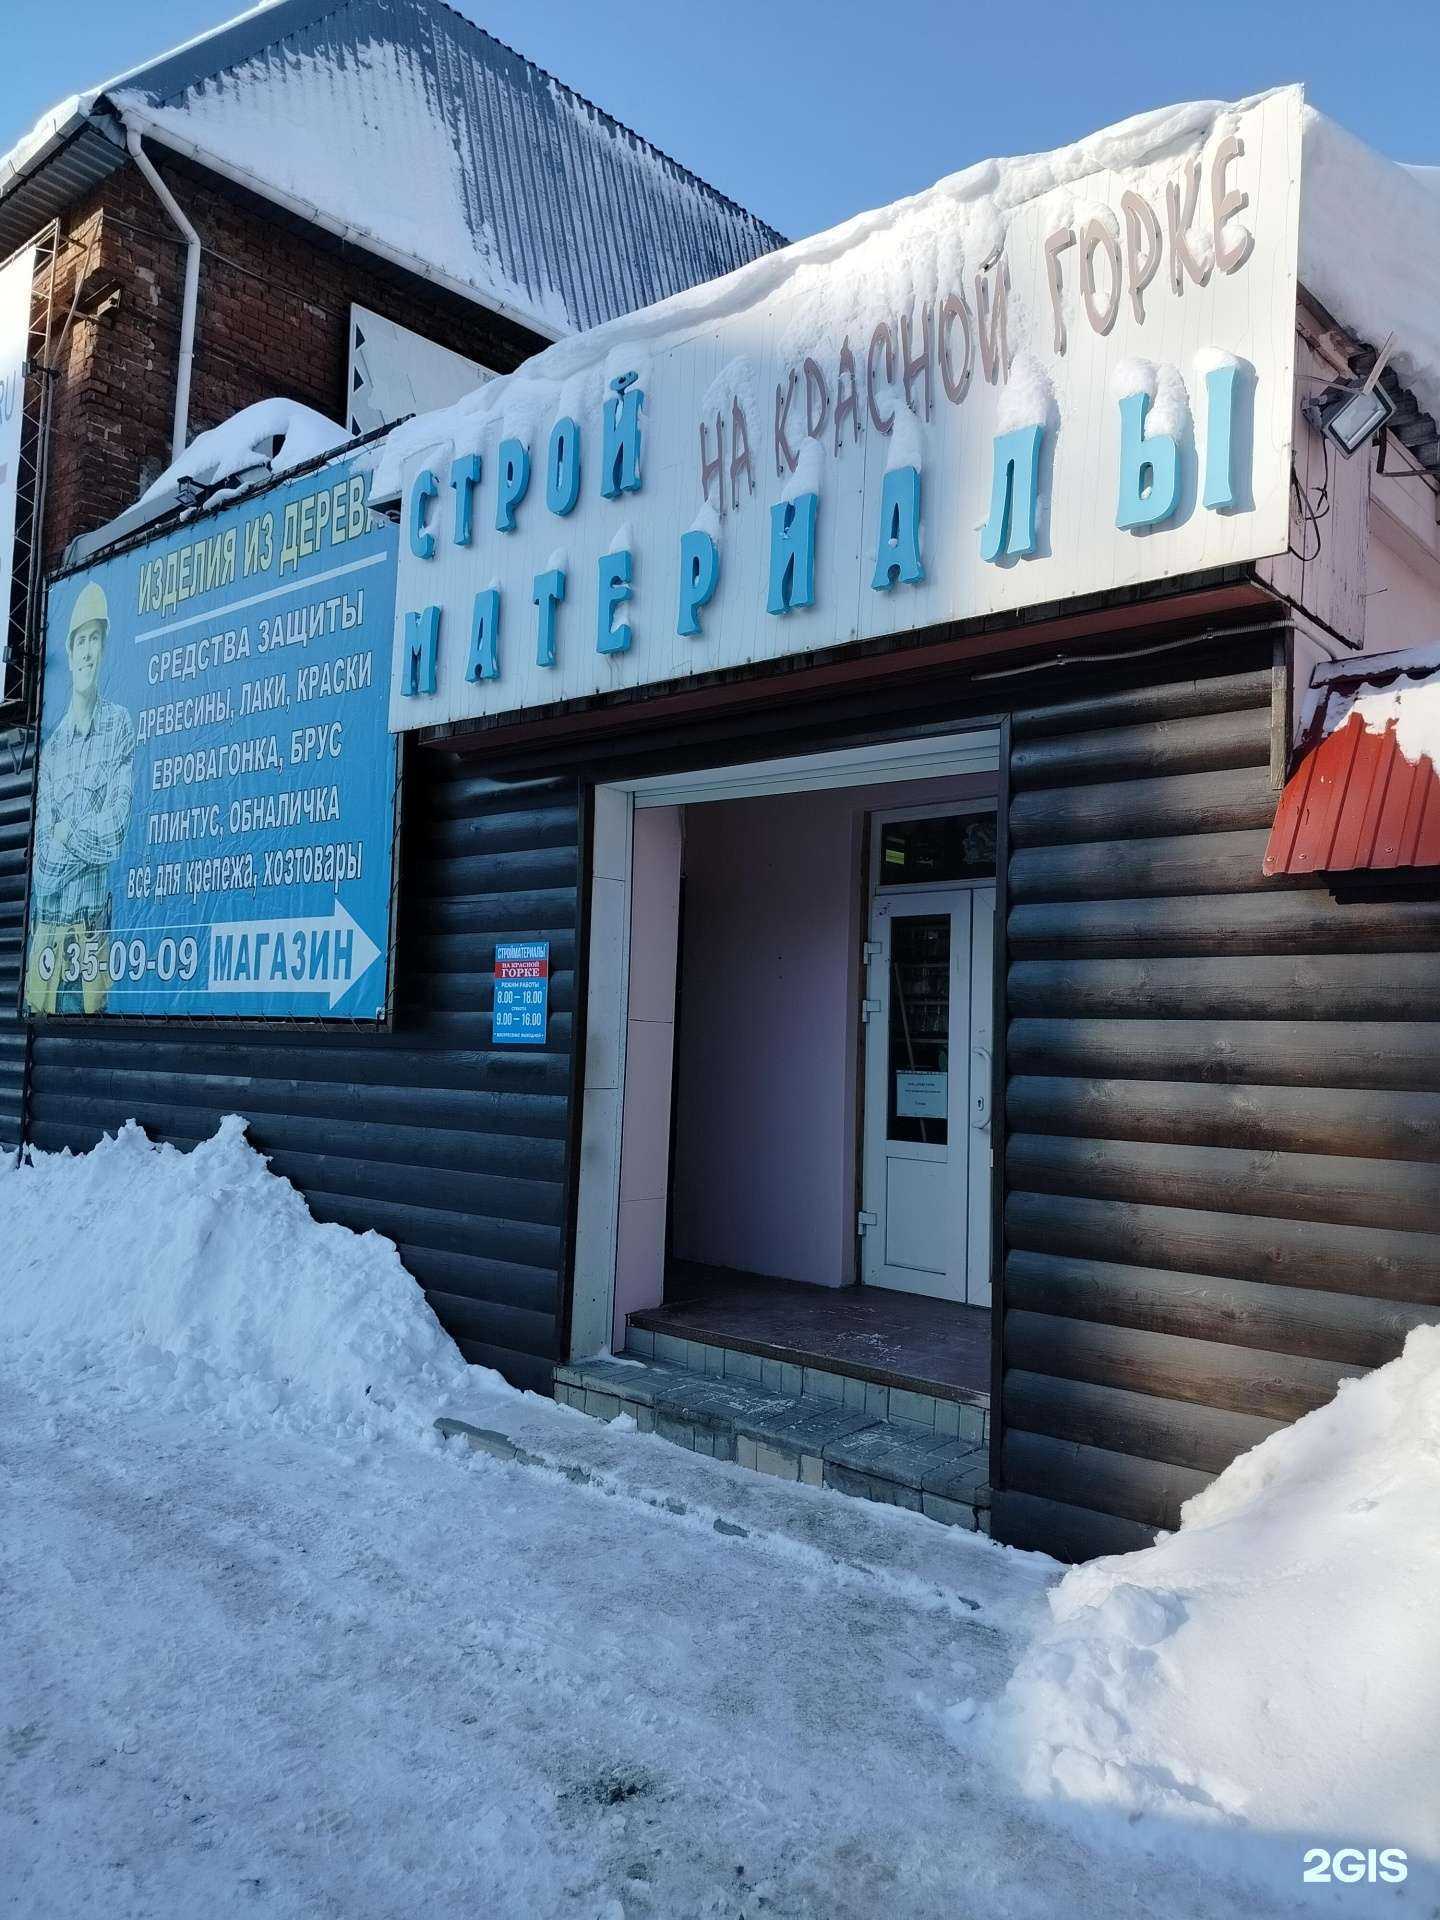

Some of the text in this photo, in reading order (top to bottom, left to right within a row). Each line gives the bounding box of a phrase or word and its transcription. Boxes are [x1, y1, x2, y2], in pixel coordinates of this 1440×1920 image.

[699, 136, 1255, 514] НА КРАСНОЙ ГОРКЕ
[410, 371, 644, 559] СТРОЙ
[400, 366, 1240, 697] МАТЕРИАЛЫ
[137, 527, 238, 618] ИЗДЕЛИЯ
[243, 511, 274, 578] ИЗ
[148, 590, 365, 685] СРЕДСТВА ЗАЩИТЫ
[136, 651, 373, 746] ДРЕВЕСИНЫ, ЛАКИ, КРАСКИ
[151, 721, 343, 790] ЕВРОВАГОНКА, БРУС
[148, 785, 341, 845] ПЛИНТУС, ОБНАЛИЧКА
[127, 841, 364, 905] всё для крепежа, хозтовары
[64, 935, 199, 983] 35-09-09
[213, 927, 355, 982] МАГАЗИН
[497, 945, 546, 960] СТРОЙМАТЕРИАЛЫ
[501, 968, 540, 978] ГОРКЕ
[496, 1012, 513, 1026] 9.00
[522, 1012, 542, 1026] 16.00
[497, 990, 513, 1004] 8.00
[523, 990, 543, 1004] 18.00
